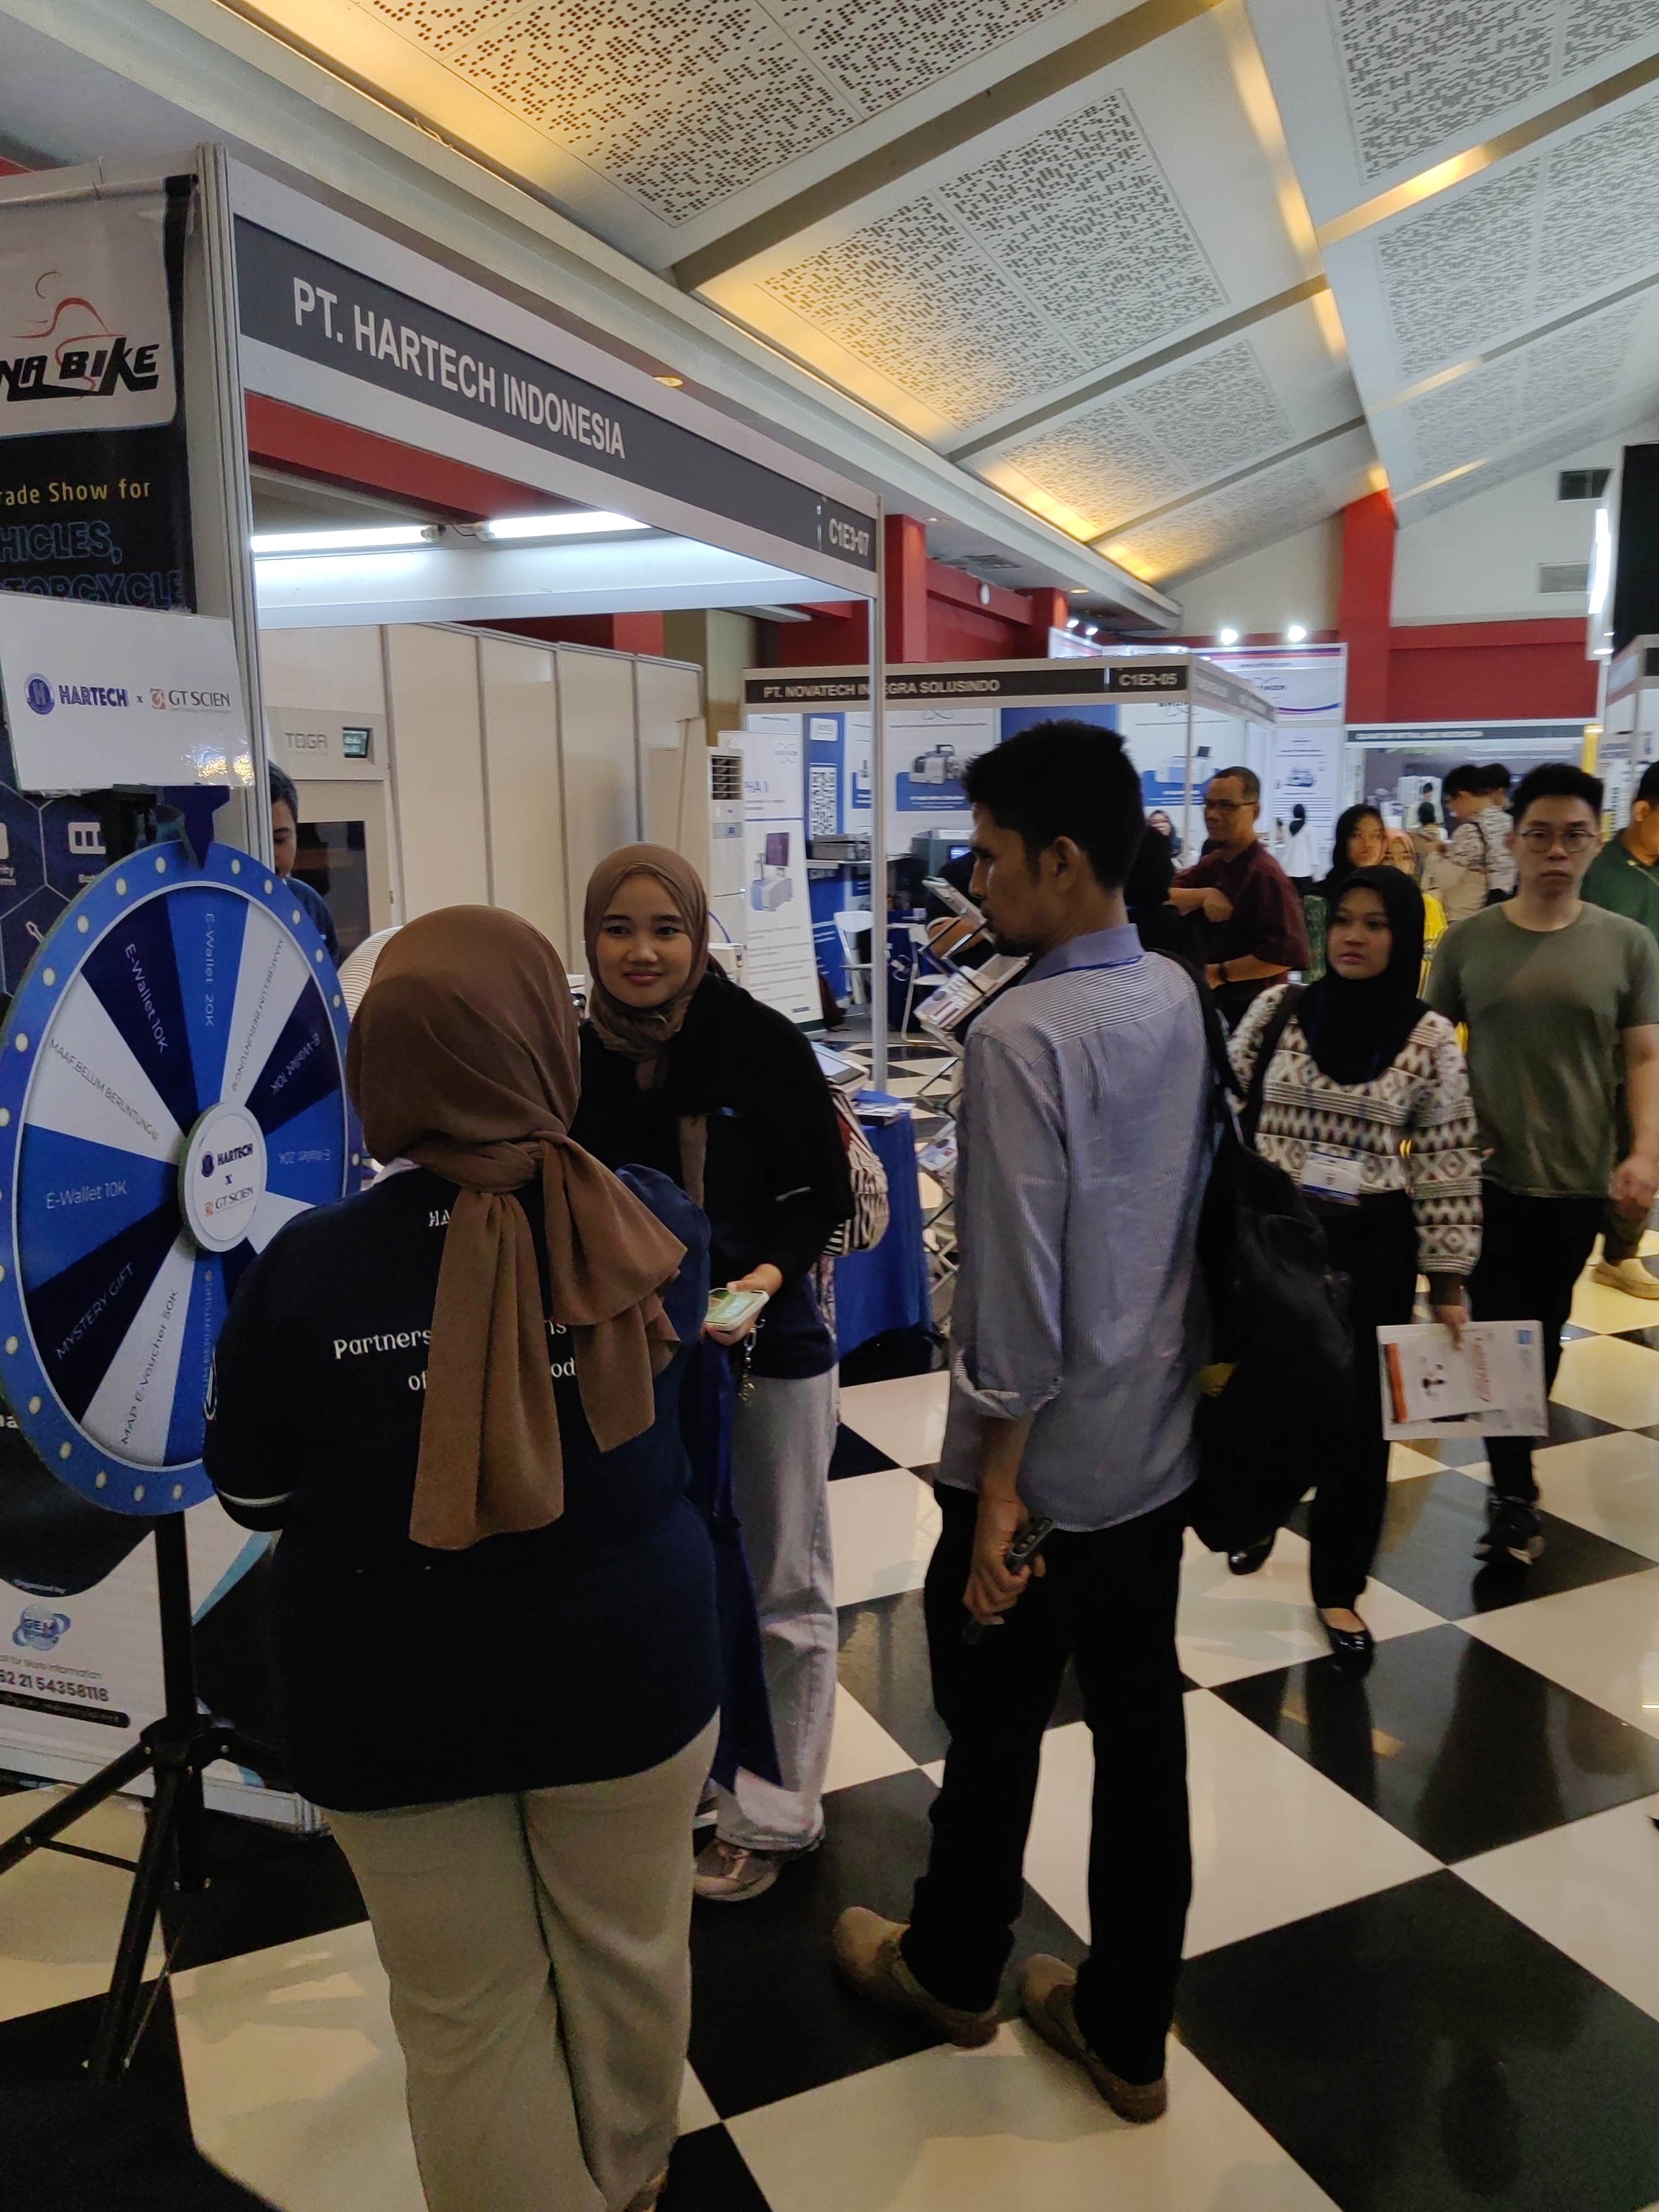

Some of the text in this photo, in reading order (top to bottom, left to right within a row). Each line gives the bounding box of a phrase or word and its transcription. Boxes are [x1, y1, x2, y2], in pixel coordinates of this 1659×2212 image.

[293, 276, 625, 459] PT. HARTECH INDONESIA
[0, 478, 151, 505] ade Show for
[58, 685, 129, 707] HARTECH
[785, 684, 856, 698] NOVATECH
[919, 679, 1001, 693] SOLUSINDO
[125, 943, 169, 1054] E-Wallet 10K
[205, 993, 214, 1027] 20K
[46, 1179, 127, 1209] E-Wallet 10K
[57, 1261, 134, 1360] MYSTERY GIFT
[333, 1328, 431, 1360] Partners
